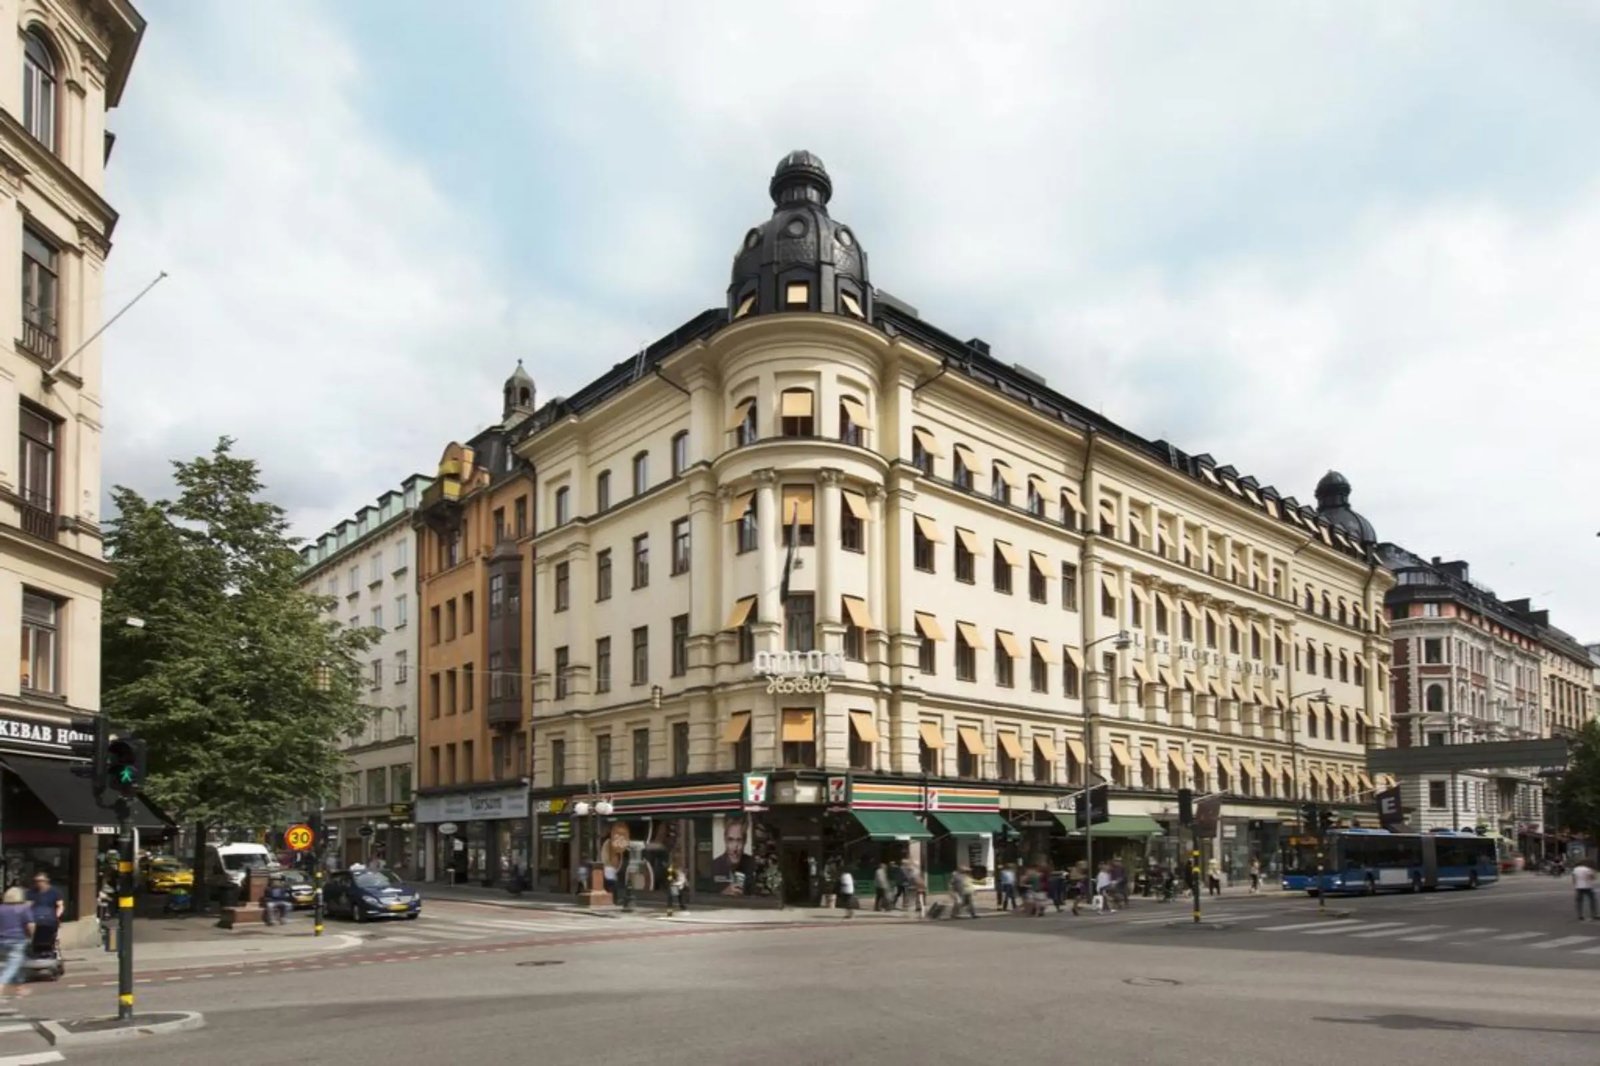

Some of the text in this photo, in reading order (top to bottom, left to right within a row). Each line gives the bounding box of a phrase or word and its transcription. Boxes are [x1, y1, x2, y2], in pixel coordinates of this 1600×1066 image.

[1178, 644, 1229, 669] HOTEL
[0, 719, 52, 741] KEBAB
[291, 832, 310, 844] 30
